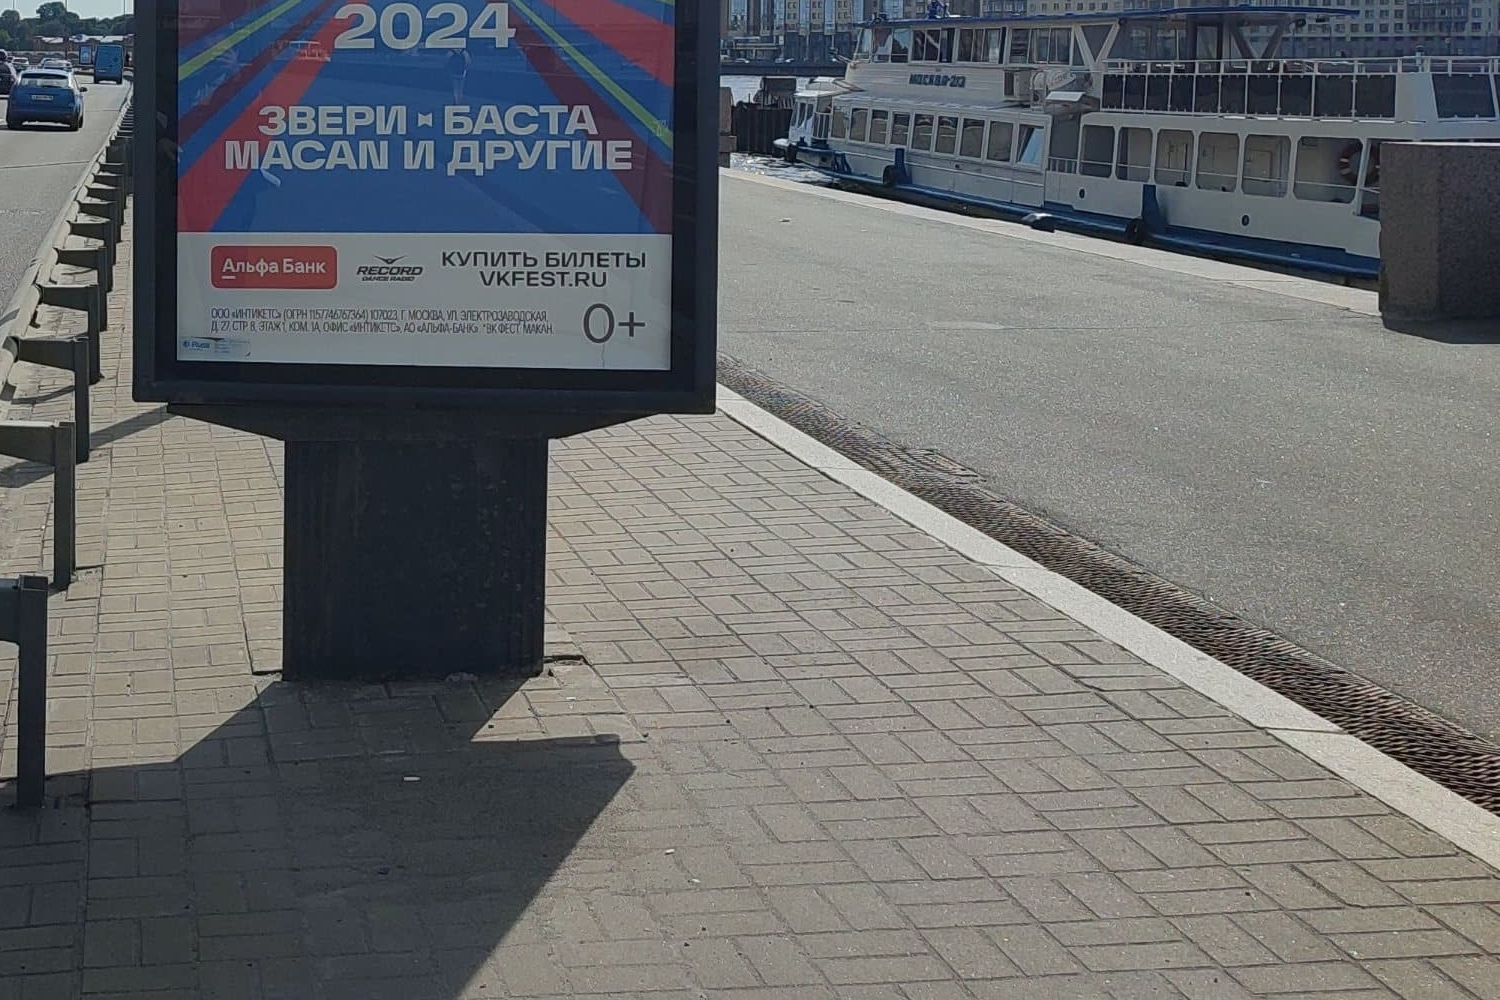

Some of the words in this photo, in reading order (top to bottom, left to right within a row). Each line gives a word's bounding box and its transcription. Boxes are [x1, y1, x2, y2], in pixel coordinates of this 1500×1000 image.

[333, 2, 516, 50] 2024
[258, 105, 407, 136] ЗВЕРИ
[444, 104, 599, 136] БАСТА
[404, 140, 434, 170] И
[447, 140, 632, 176] ДРУГИЕ
[221, 258, 279, 278] Альфа
[283, 258, 326, 274] Банк
[442, 251, 538, 268] КУПИТЬ
[545, 252, 646, 268] БИЛЕТЫ
[356, 266, 424, 276] RECORD
[479, 271, 607, 288] VKFEST.RU
[211, 308, 230, 319] ООО
[232, 308, 282, 319] «ИНТИКЕТС»
[283, 308, 307, 320] (ОГРН
[258, 321, 281, 331] ЭТАЖ
[323, 322, 348, 332] ОФИС
[404, 323, 415, 333] АО
[583, 303, 646, 344] 0+
